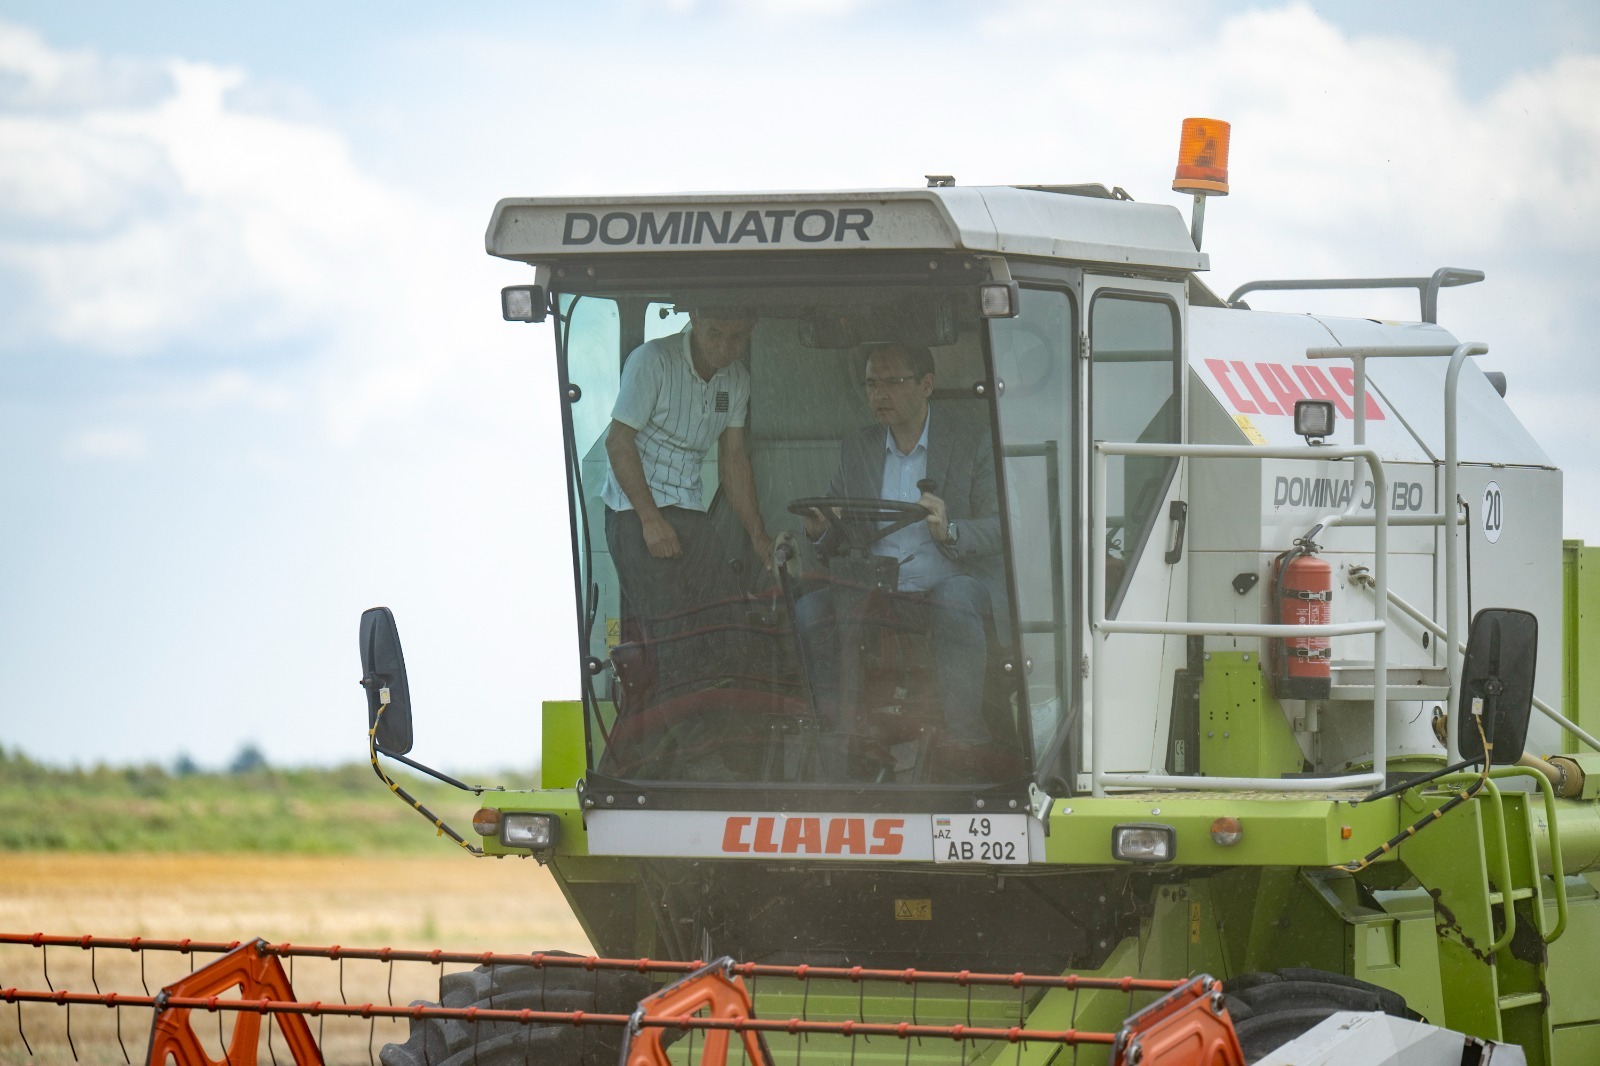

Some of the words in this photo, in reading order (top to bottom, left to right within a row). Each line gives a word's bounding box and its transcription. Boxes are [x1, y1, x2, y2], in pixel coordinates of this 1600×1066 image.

[562, 208, 874, 245] DOMINATOR
[1204, 358, 1386, 421] CLAAS
[1274, 476, 1389, 510] DOMINAO
[1485, 490, 1501, 531] 20
[721, 816, 905, 855] CLAAS
[938, 830, 951, 839] AZ
[969, 818, 991, 836] 49
[948, 841, 974, 860] AB
[980, 841, 1015, 860] 202
